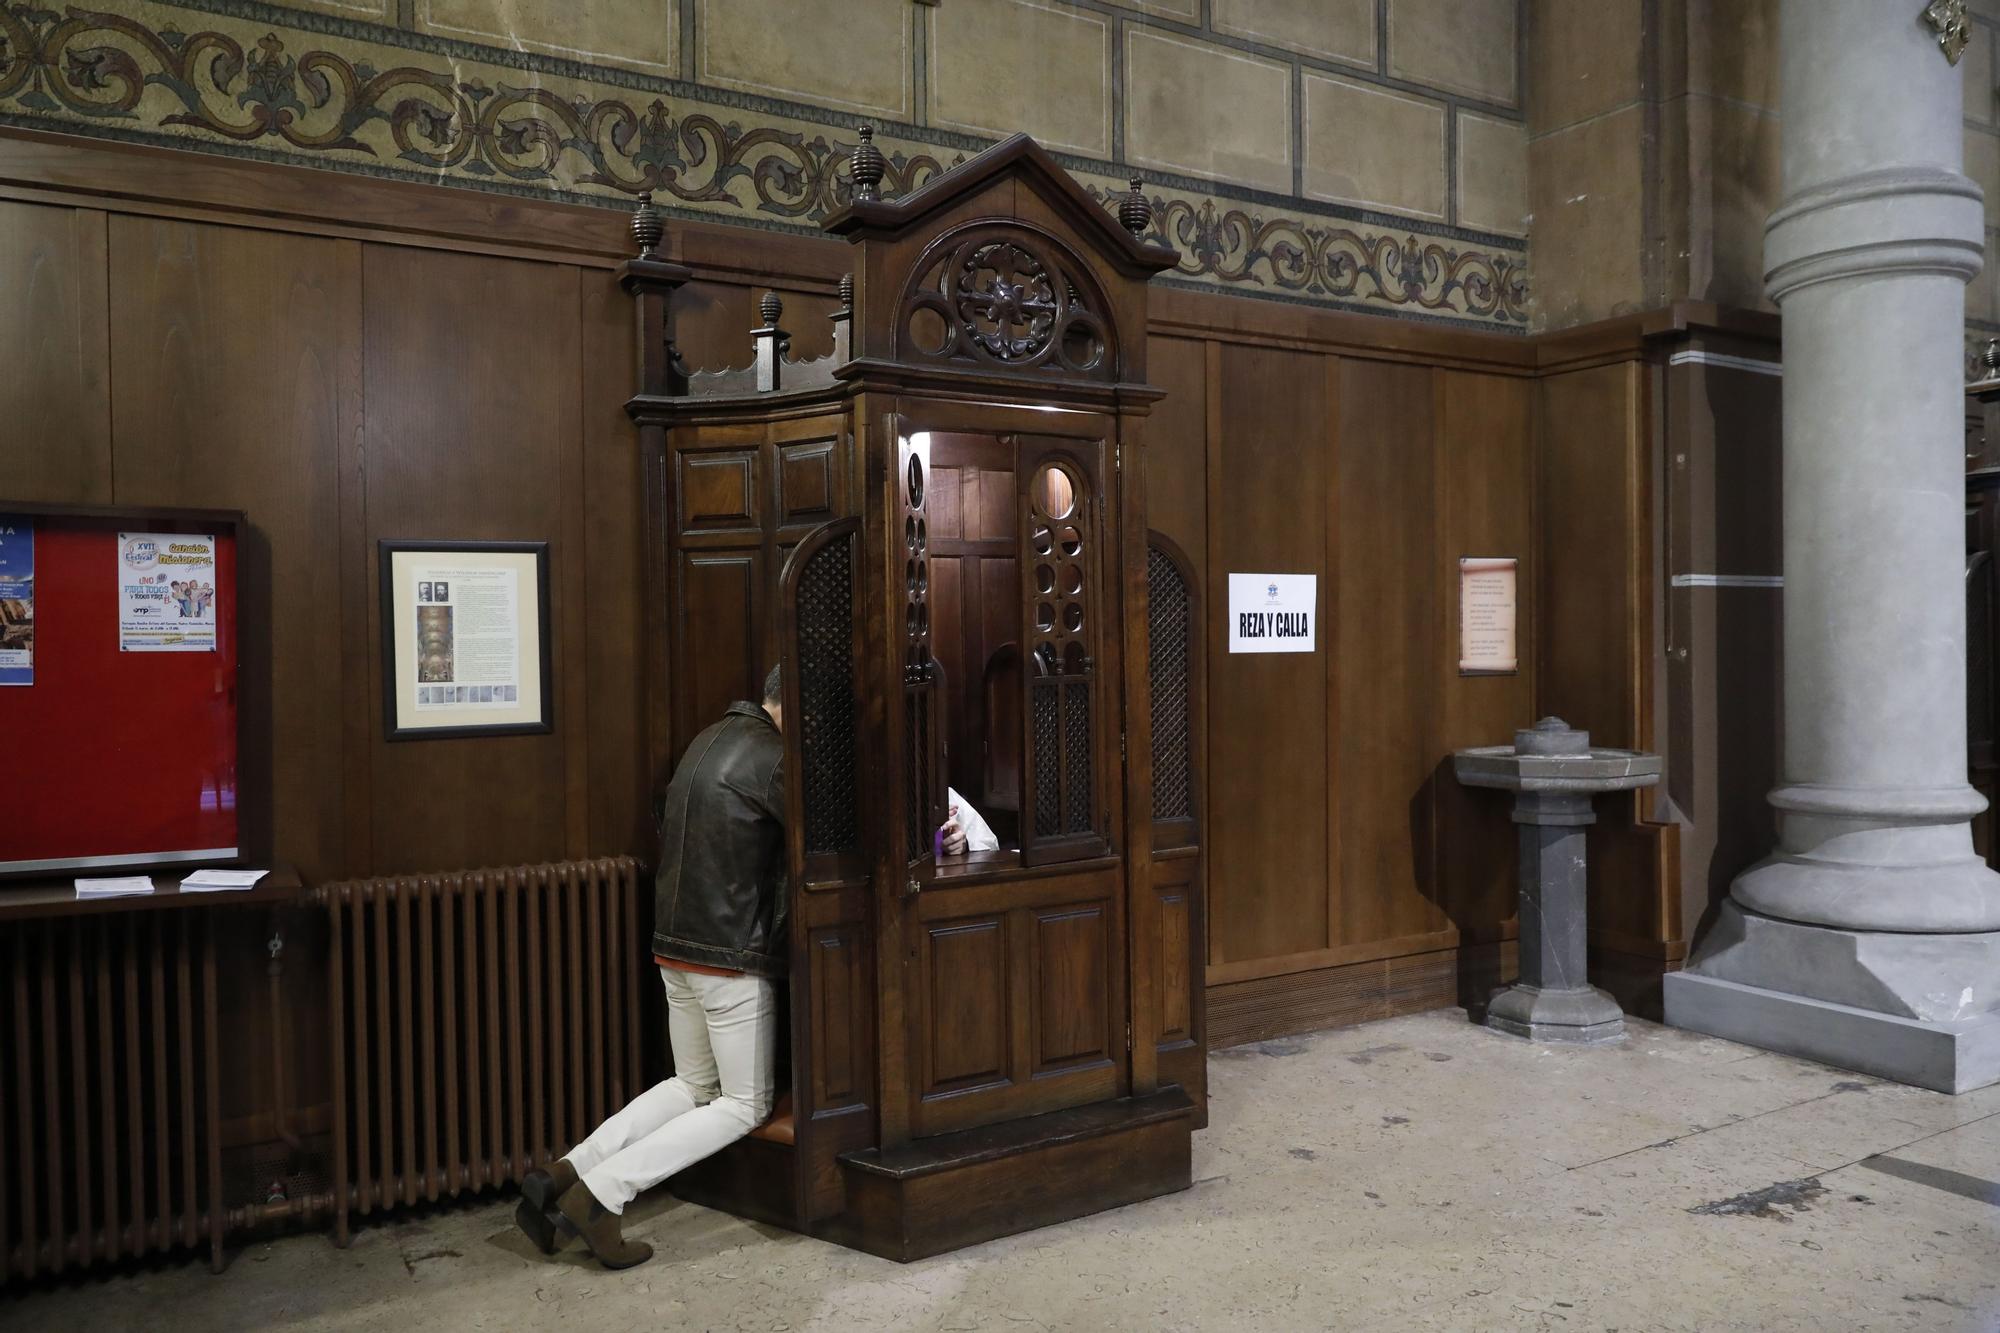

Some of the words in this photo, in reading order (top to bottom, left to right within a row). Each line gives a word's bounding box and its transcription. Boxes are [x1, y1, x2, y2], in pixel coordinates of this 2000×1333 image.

[126, 553, 153, 561] Festival
[1240, 612, 1265, 638] REZA
[1267, 612, 1273, 637] Y
[1276, 612, 1308, 638] CALLA
